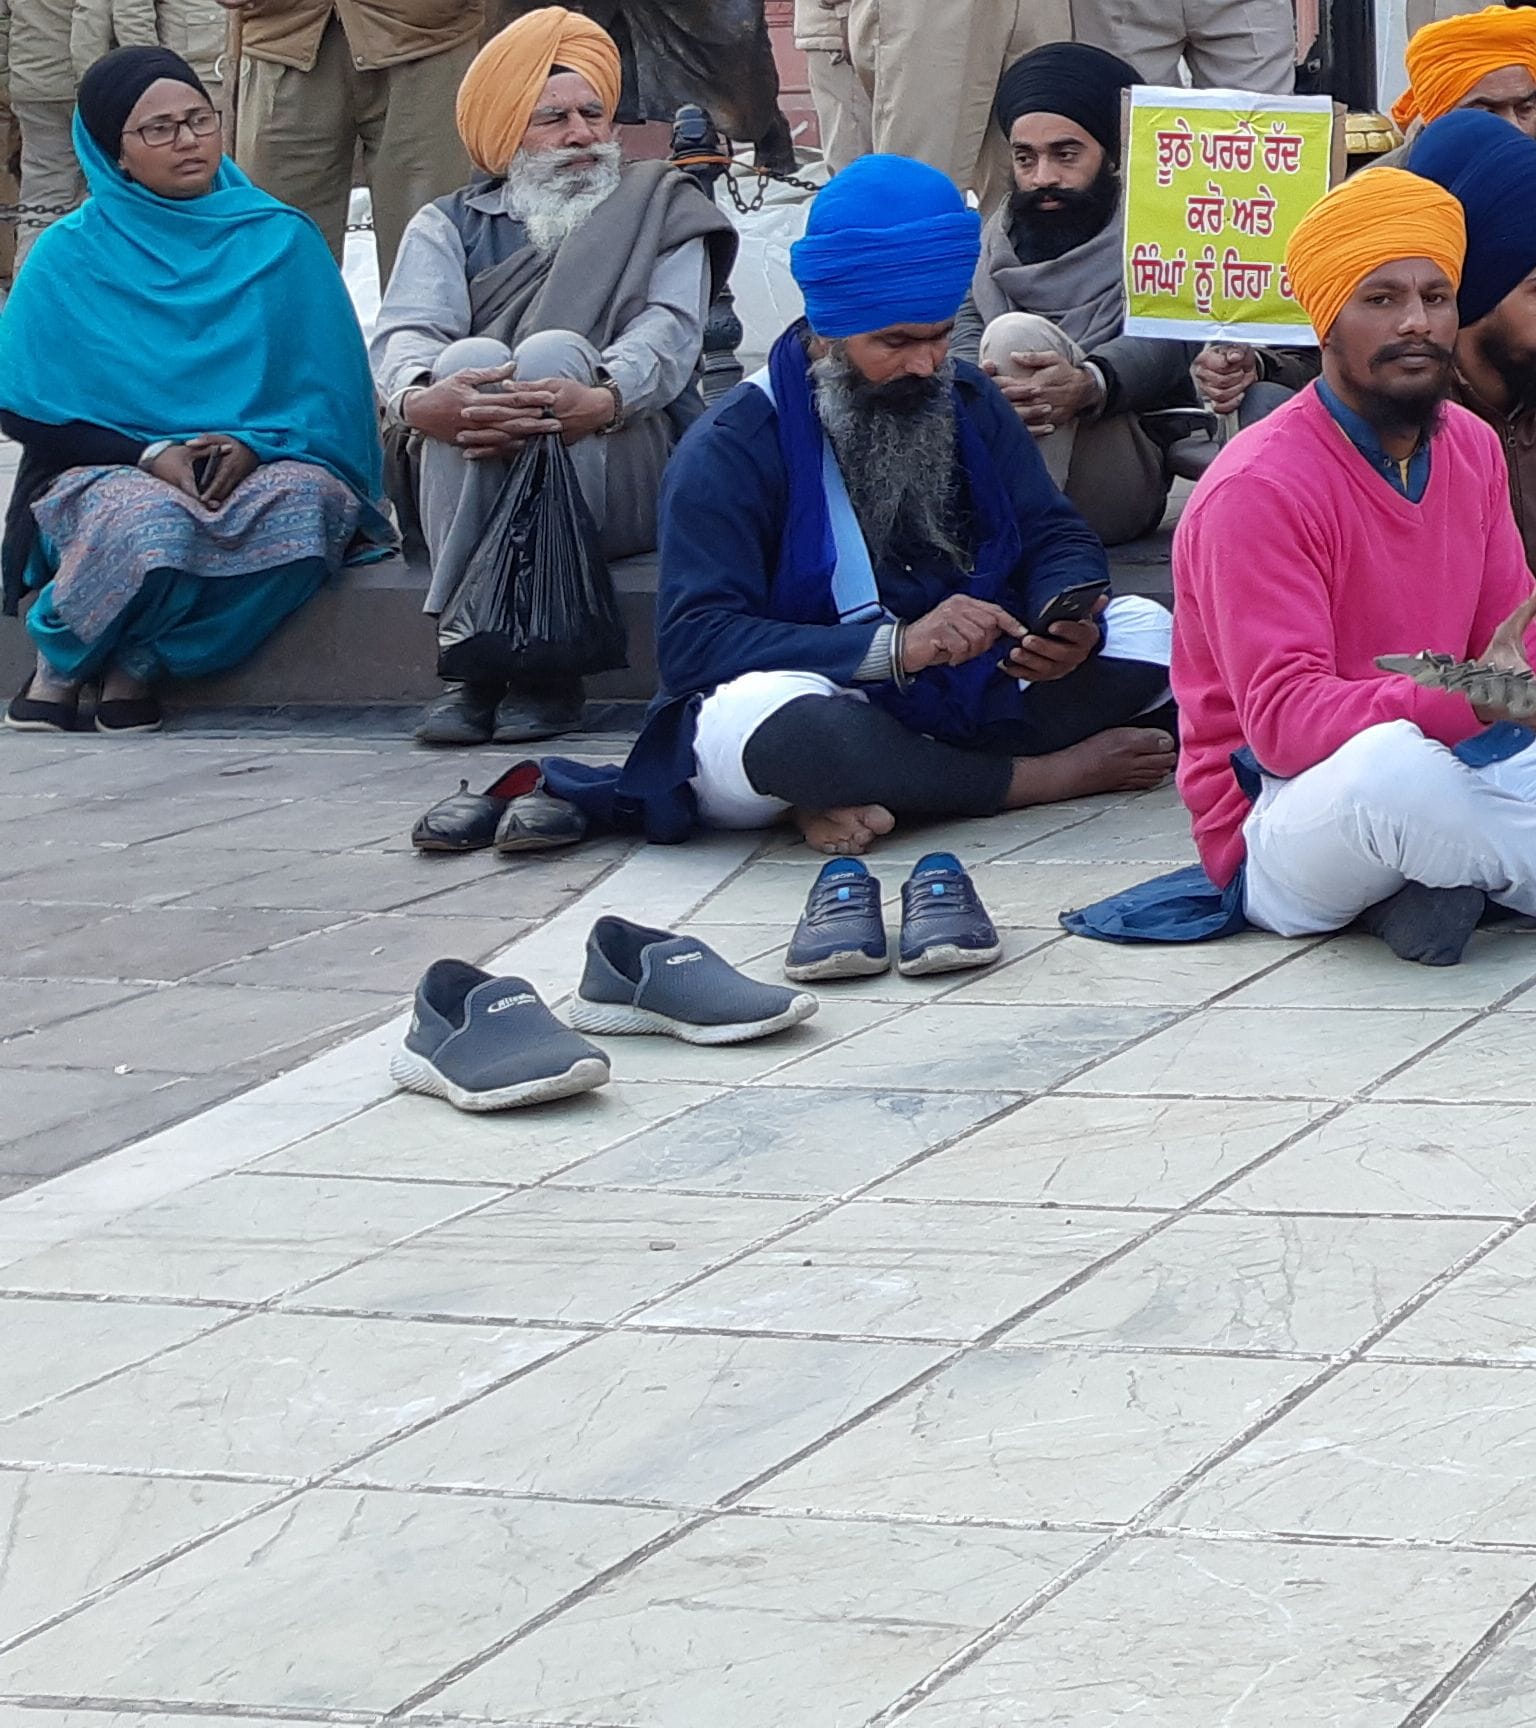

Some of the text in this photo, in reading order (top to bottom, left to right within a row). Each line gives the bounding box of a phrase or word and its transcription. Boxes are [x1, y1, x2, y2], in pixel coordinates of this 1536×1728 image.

[1158, 119, 1193, 184] ਝੂਠੇ
[1264, 123, 1302, 171] ਰੱਦ
[1188, 181, 1275, 235] ਕਰੋ ਅਤੇ
[1132, 244, 1186, 295] ਸਿੰਘਾਂ
[1195, 246, 1215, 313] ਨੂੰ
[1223, 249, 1272, 298] ਰਿਹਾ
